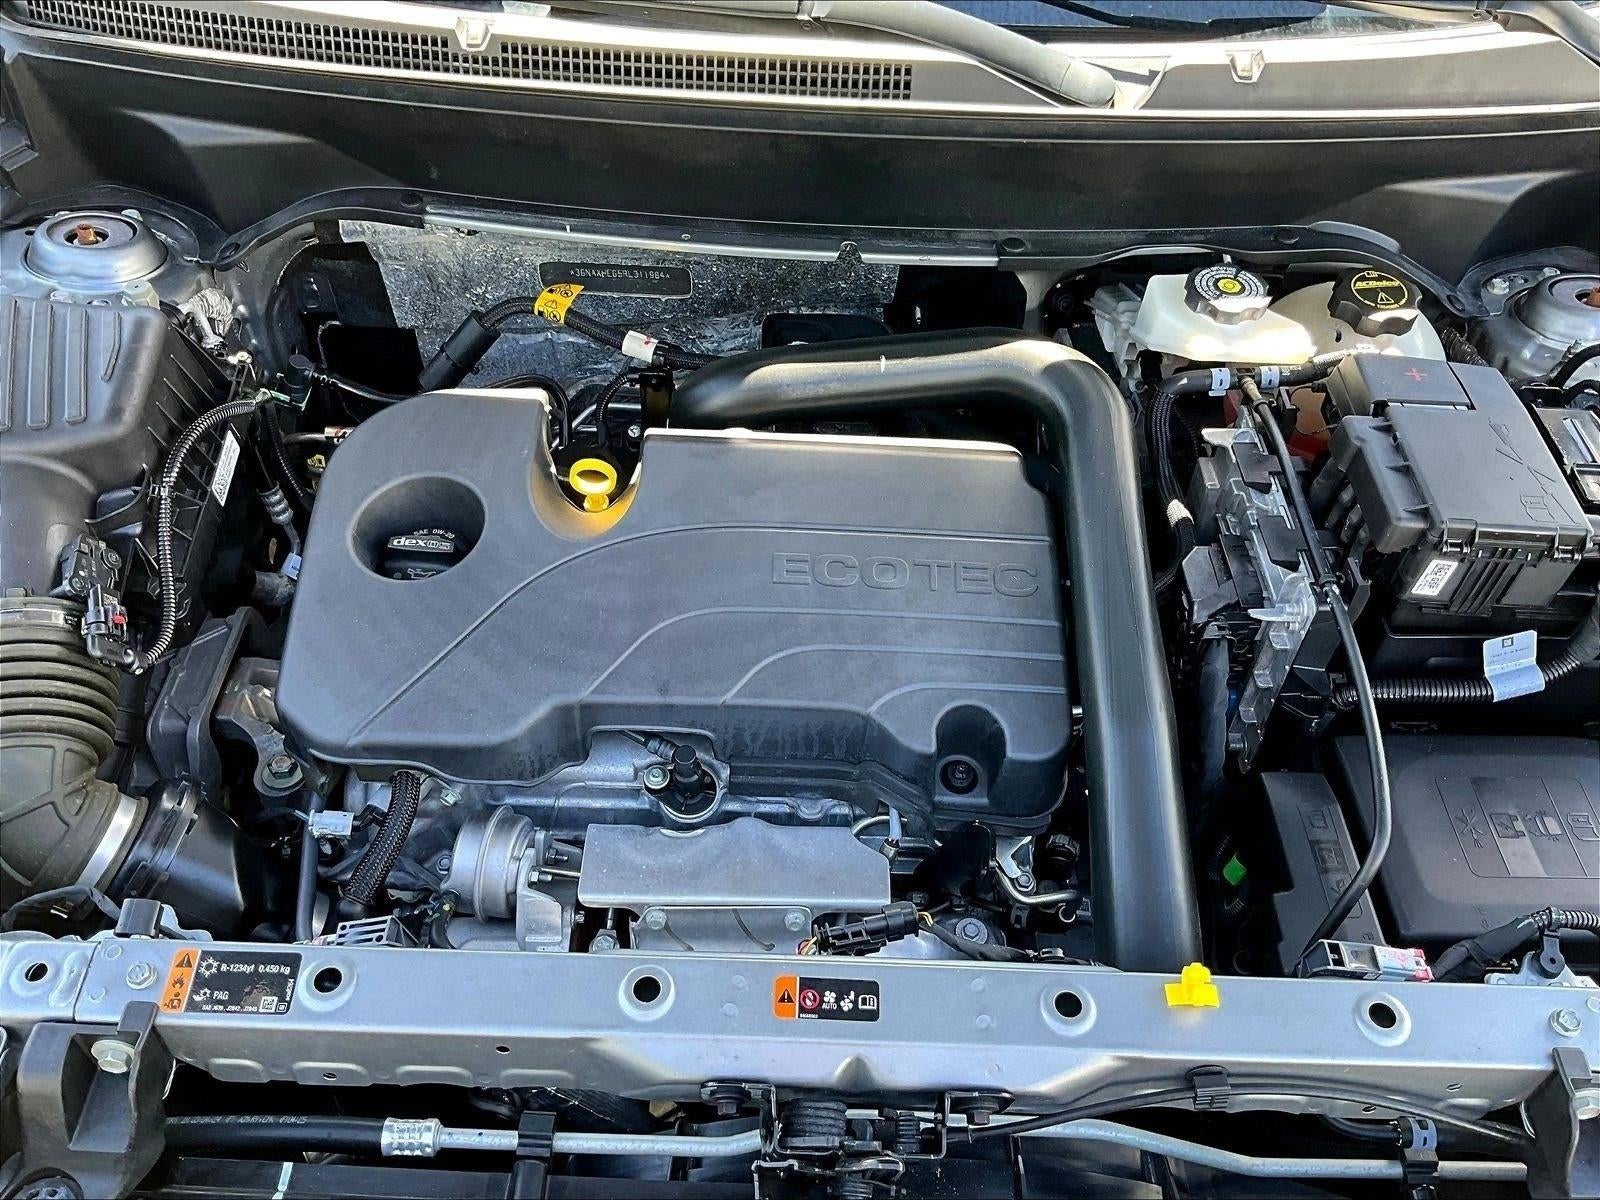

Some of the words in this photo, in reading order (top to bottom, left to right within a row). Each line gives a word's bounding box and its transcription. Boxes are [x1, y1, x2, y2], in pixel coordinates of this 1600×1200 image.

[432, 528, 455, 539] 0W-20
[393, 537, 451, 550] dexos
[772, 552, 1039, 597] ECOTEC
[220, 963, 255, 974] R-1234yf
[258, 964, 280, 974] 0.450
[280, 966, 291, 975] kg
[213, 990, 229, 1000] PAG
[821, 1002, 838, 1010] AUTO
